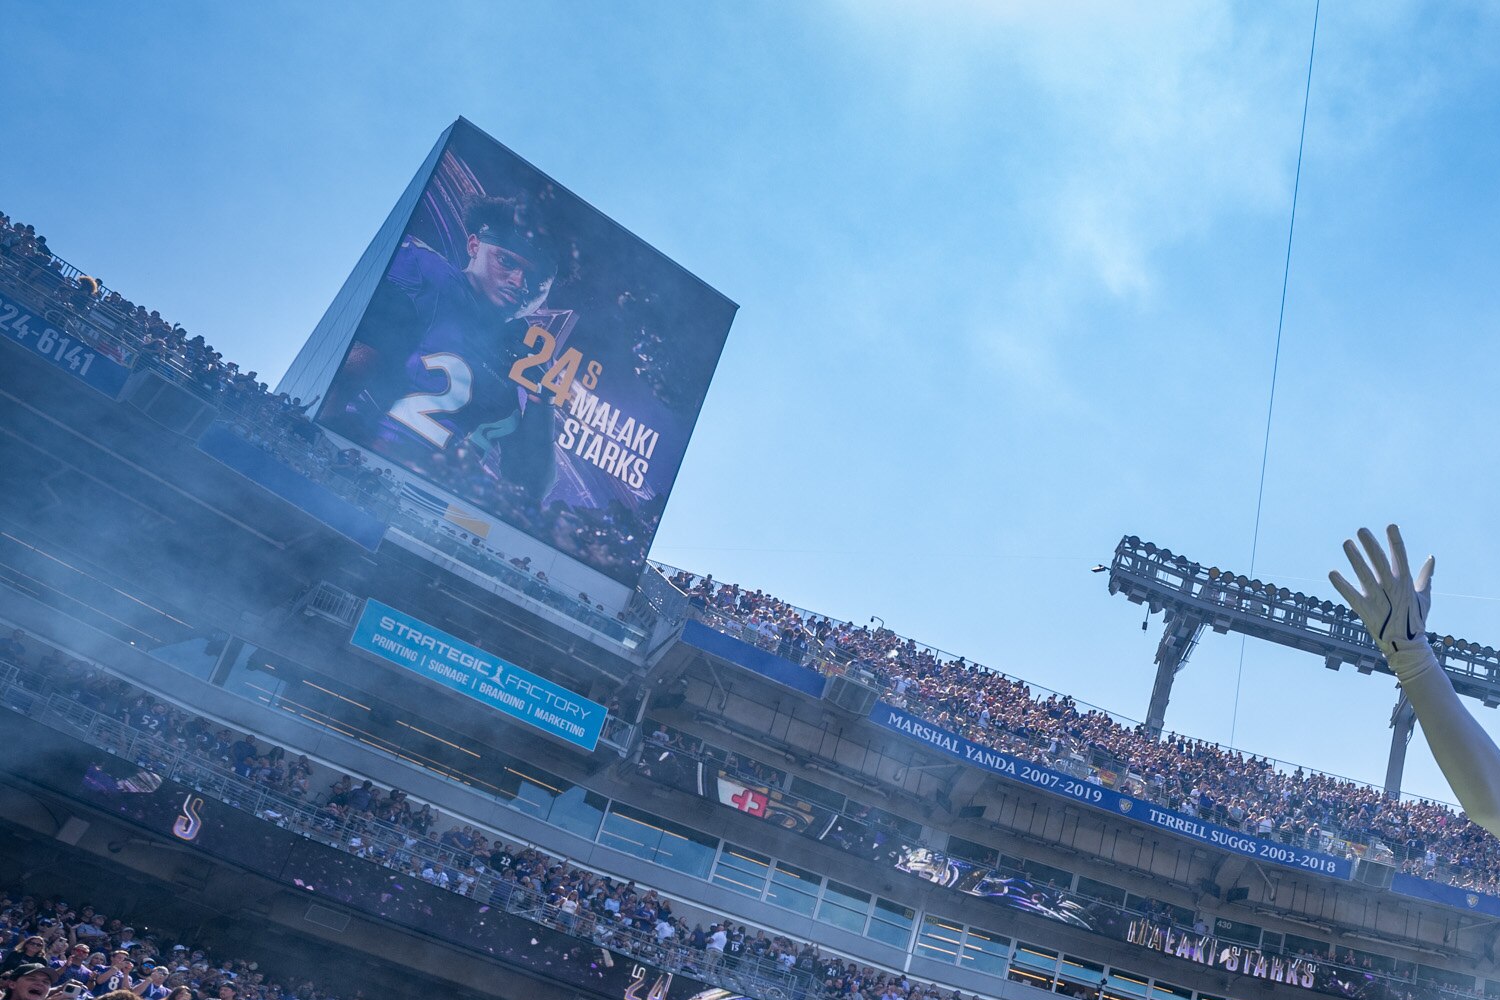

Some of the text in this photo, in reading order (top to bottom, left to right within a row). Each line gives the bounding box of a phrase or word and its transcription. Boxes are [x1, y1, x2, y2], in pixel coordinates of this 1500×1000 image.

[508, 326, 583, 408] 24
[557, 418, 649, 489] STARKS
[569, 386, 660, 460] MALAKI
[371, 633, 585, 738] PRINTING SIGNAGE BRANDING MARKETING
[379, 616, 592, 720] STRATEGIC FACTORY
[888, 712, 960, 754] MARSHAL
[964, 745, 1016, 775] YANDA
[1020, 766, 1103, 803] 2007-2019
[1149, 809, 1337, 874] TERRELL SUGGS 2003-2018
[1126, 918, 1317, 988] MALAKI STARKS
[1216, 919, 1233, 931] 430
[108, 976, 120, 991] 8
